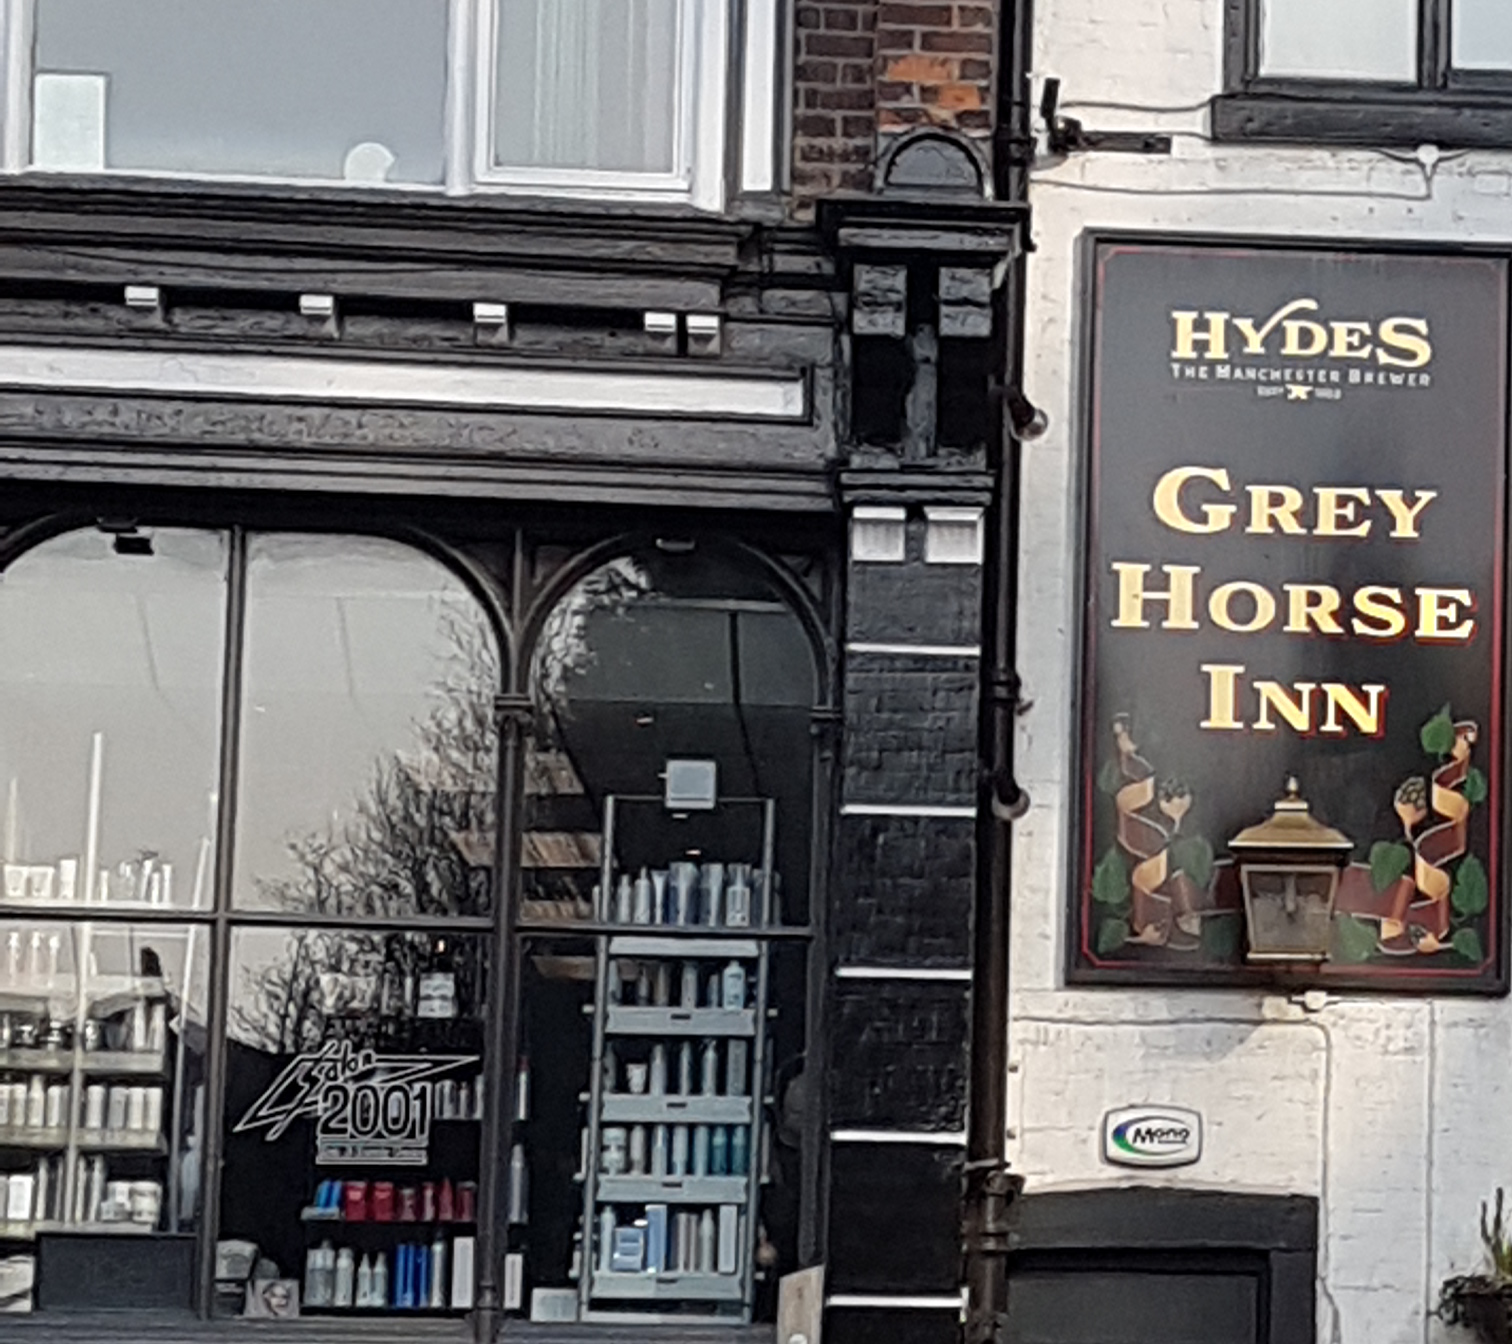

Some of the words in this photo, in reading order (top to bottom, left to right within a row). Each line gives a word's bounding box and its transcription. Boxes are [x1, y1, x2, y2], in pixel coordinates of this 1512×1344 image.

[1170, 298, 1432, 368] HYDES
[1170, 362, 1208, 380] THE
[1215, 364, 1340, 384] MANCHESTER
[1348, 368, 1432, 388] BREWER
[1152, 465, 1439, 540] GREY
[1110, 562, 1477, 642] HORSE
[1200, 663, 1388, 736] INN
[318, 1082, 431, 1138] 2001
